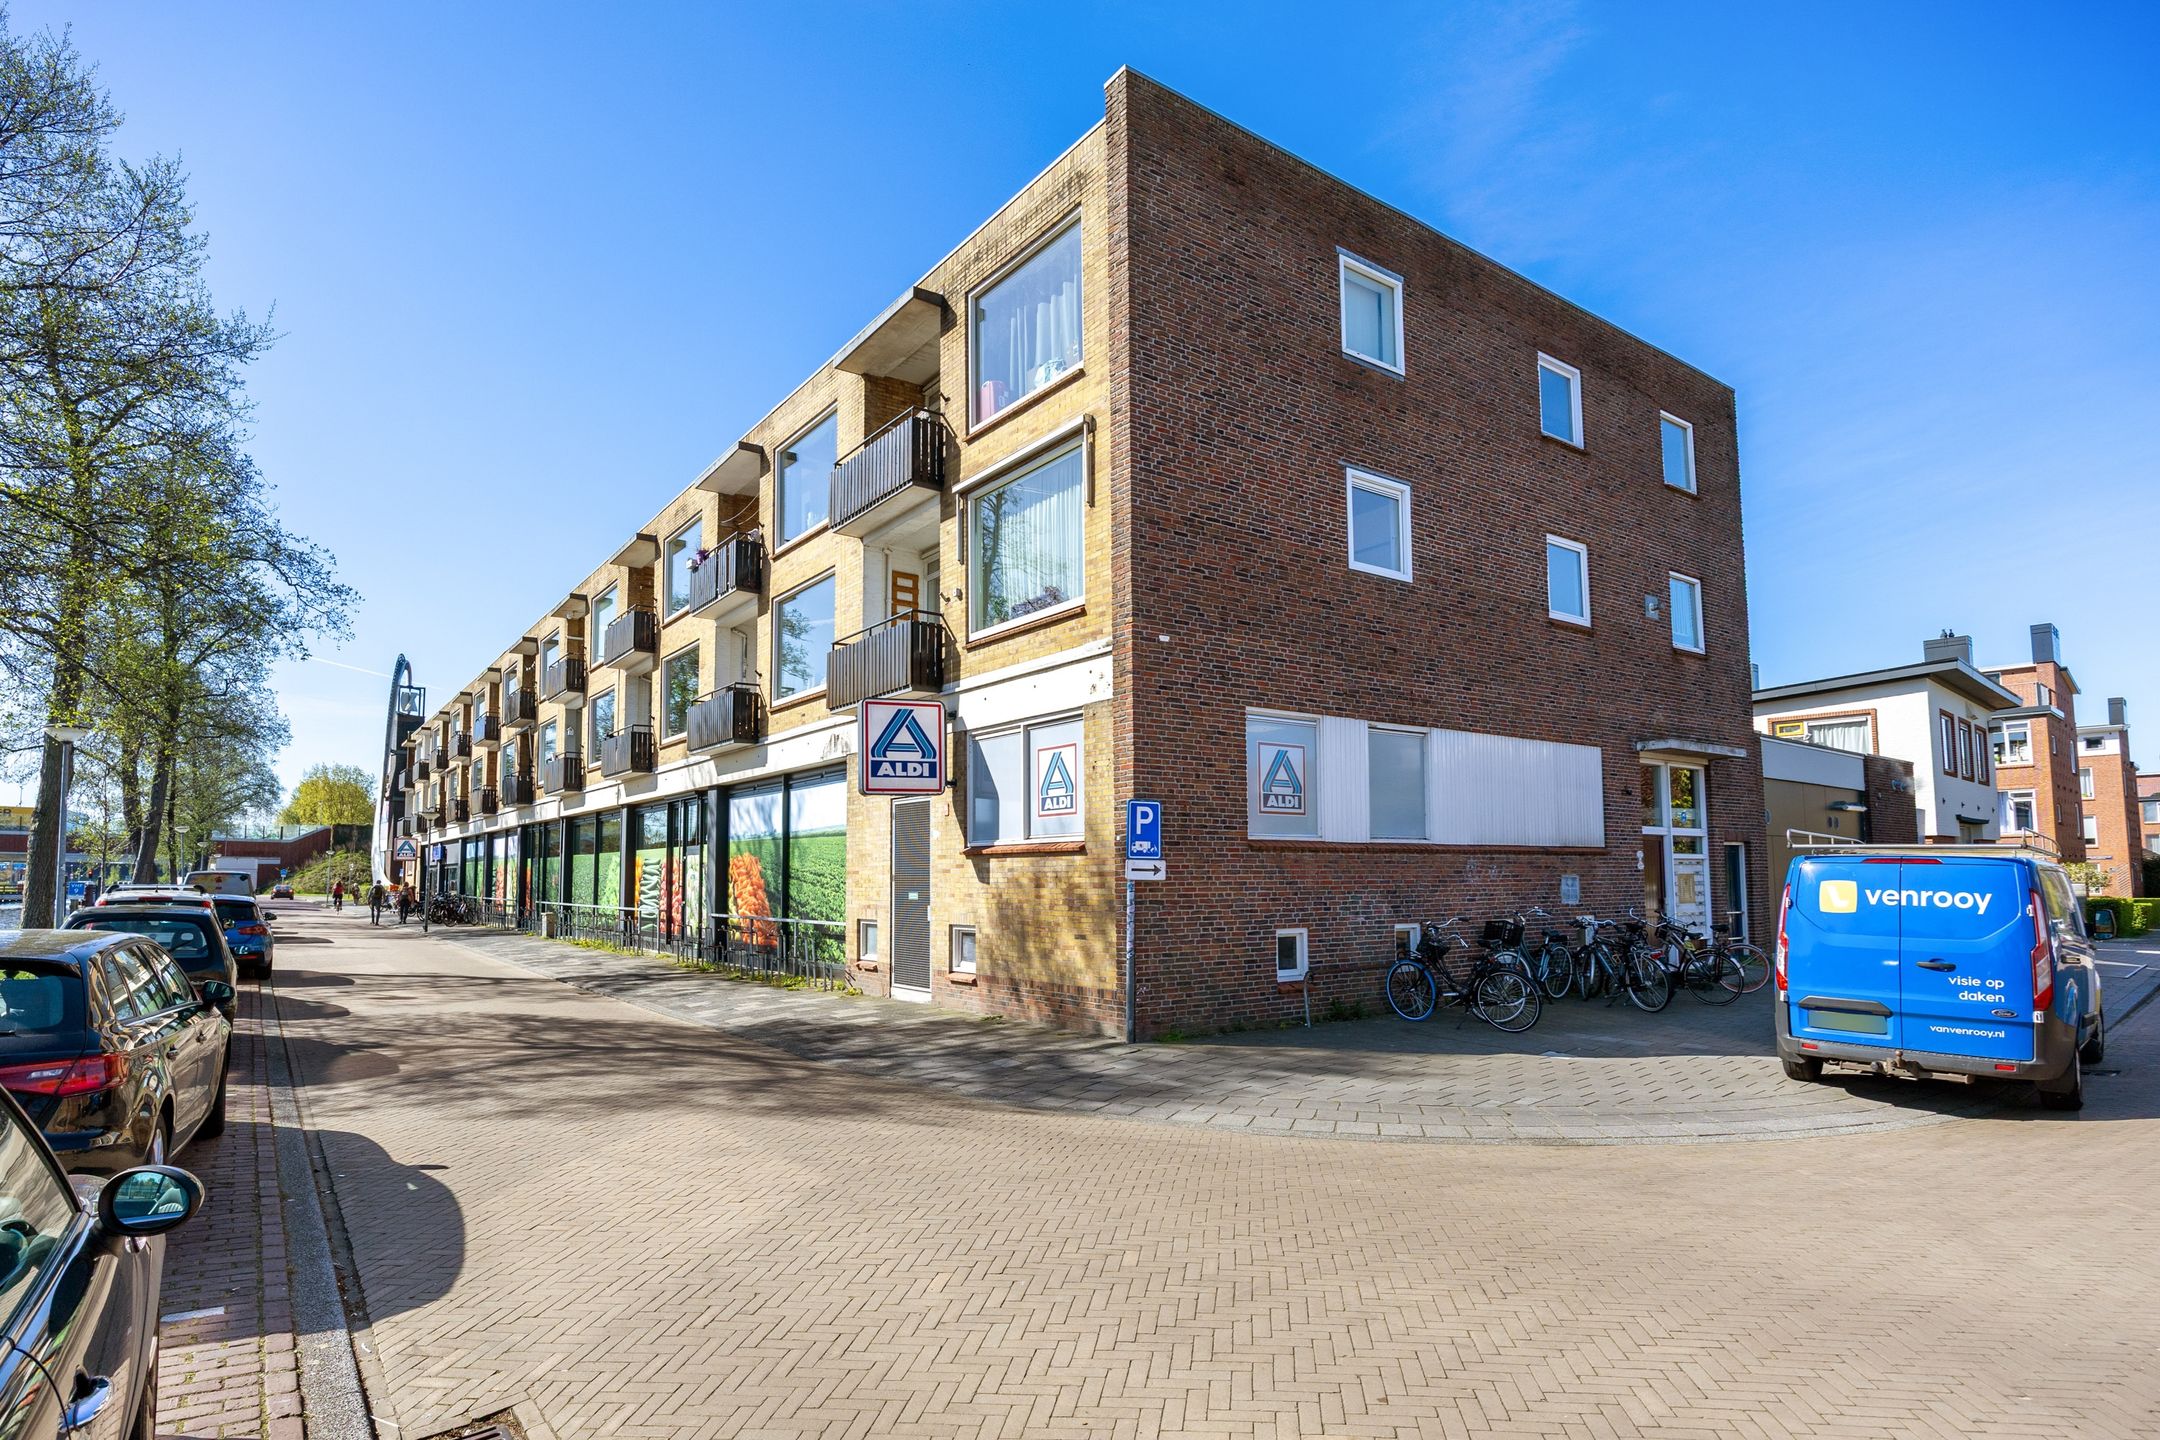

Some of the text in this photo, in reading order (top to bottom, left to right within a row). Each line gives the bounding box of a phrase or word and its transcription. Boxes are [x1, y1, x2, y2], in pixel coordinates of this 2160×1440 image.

[876, 762, 930, 777] ALDI
[1043, 795, 1071, 810] ALDI
[1266, 794, 1299, 808] ALDI
[1136, 806, 1154, 835] P
[1864, 888, 1993, 915] venrooy
[1948, 975, 2005, 990] visie op
[1958, 990, 2005, 1003] daken
[1929, 1025, 2005, 1039] vanvenrooy.nl
